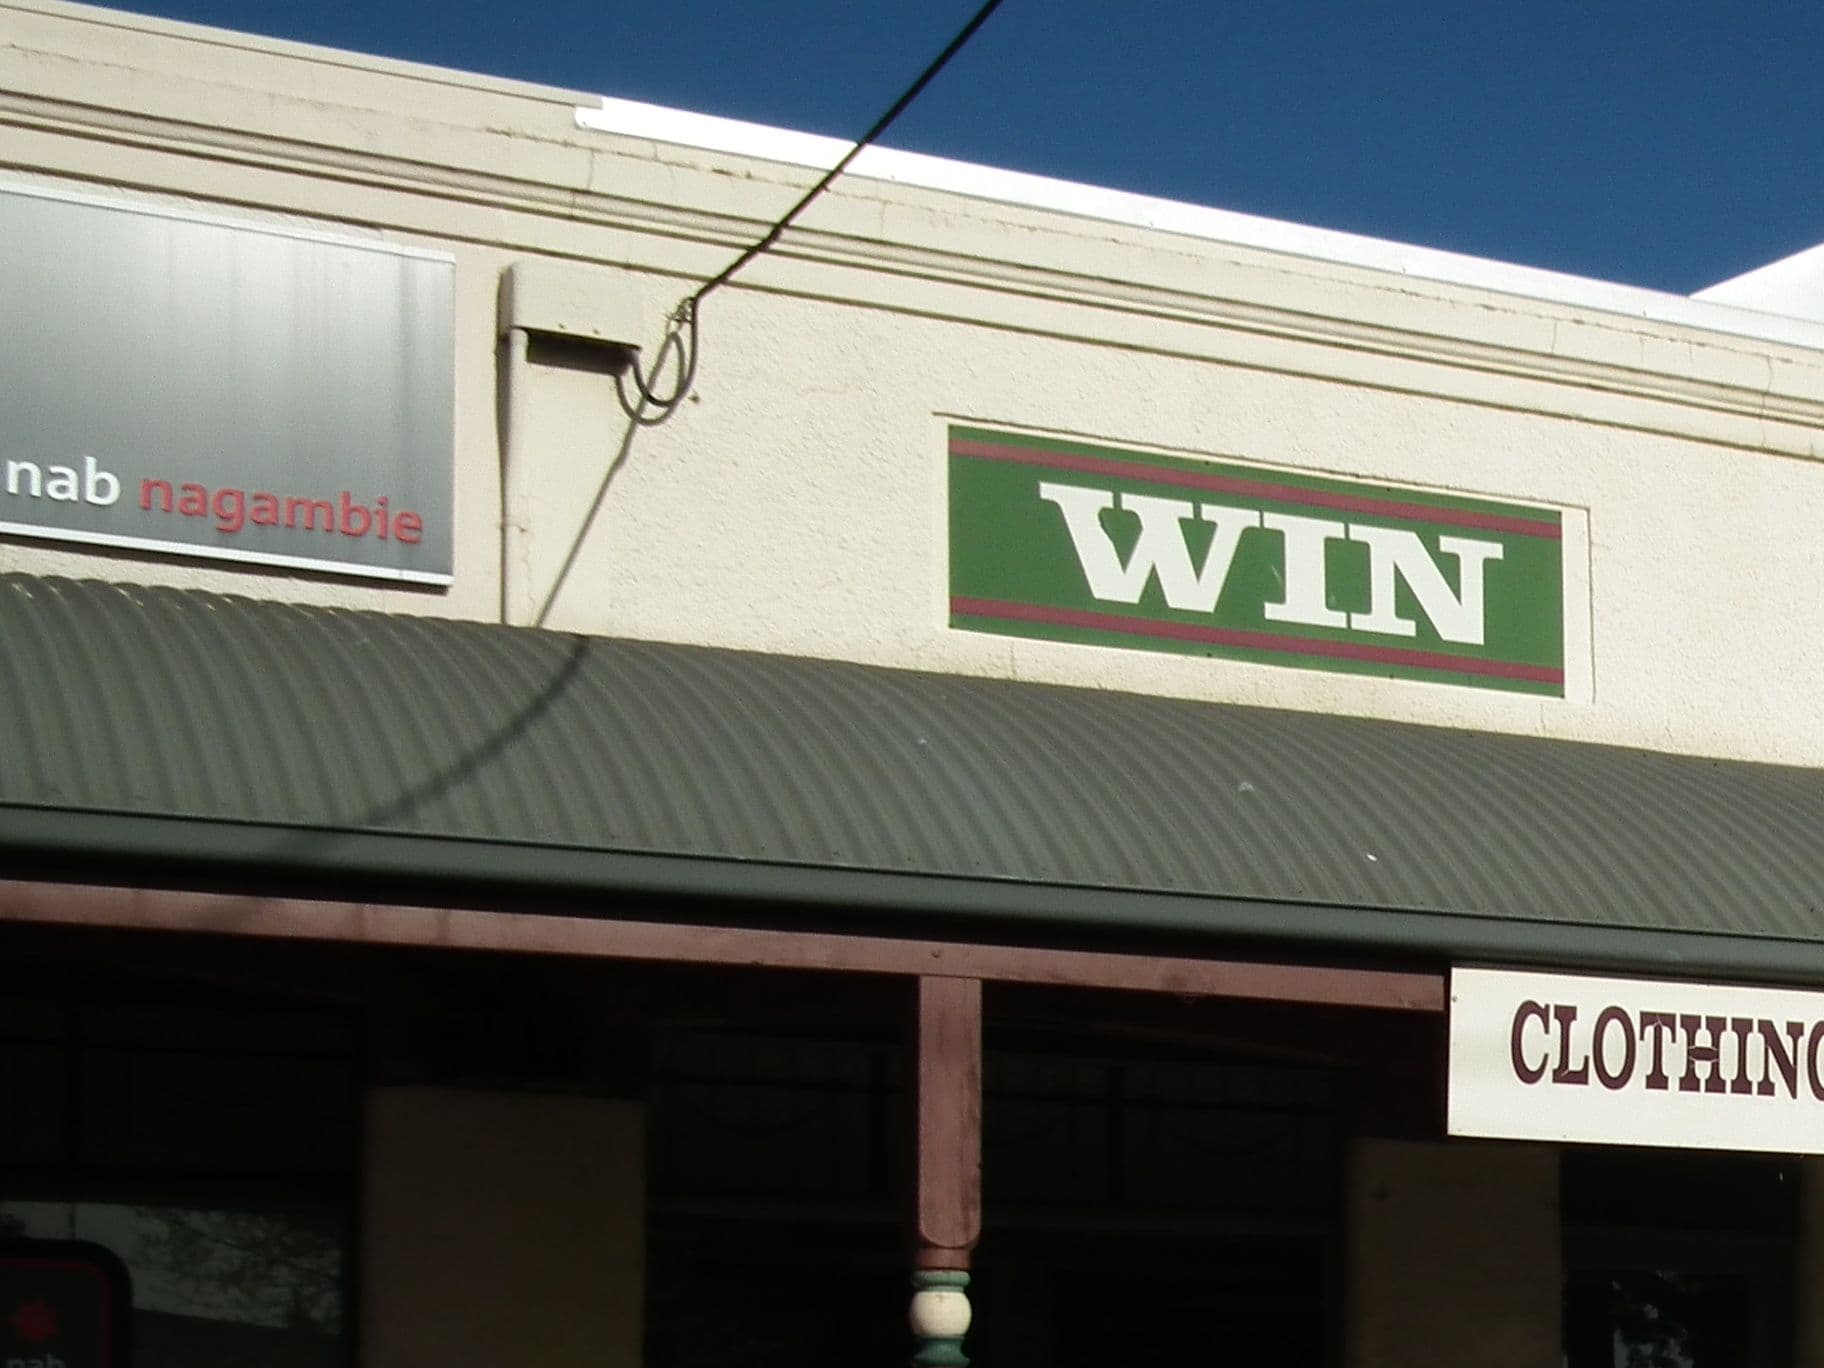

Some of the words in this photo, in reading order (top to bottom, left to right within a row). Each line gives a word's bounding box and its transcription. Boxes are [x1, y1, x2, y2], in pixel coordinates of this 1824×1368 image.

[5, 457, 121, 506] nab
[140, 475, 424, 544] nagambie
[1039, 481, 1504, 645] WIN
